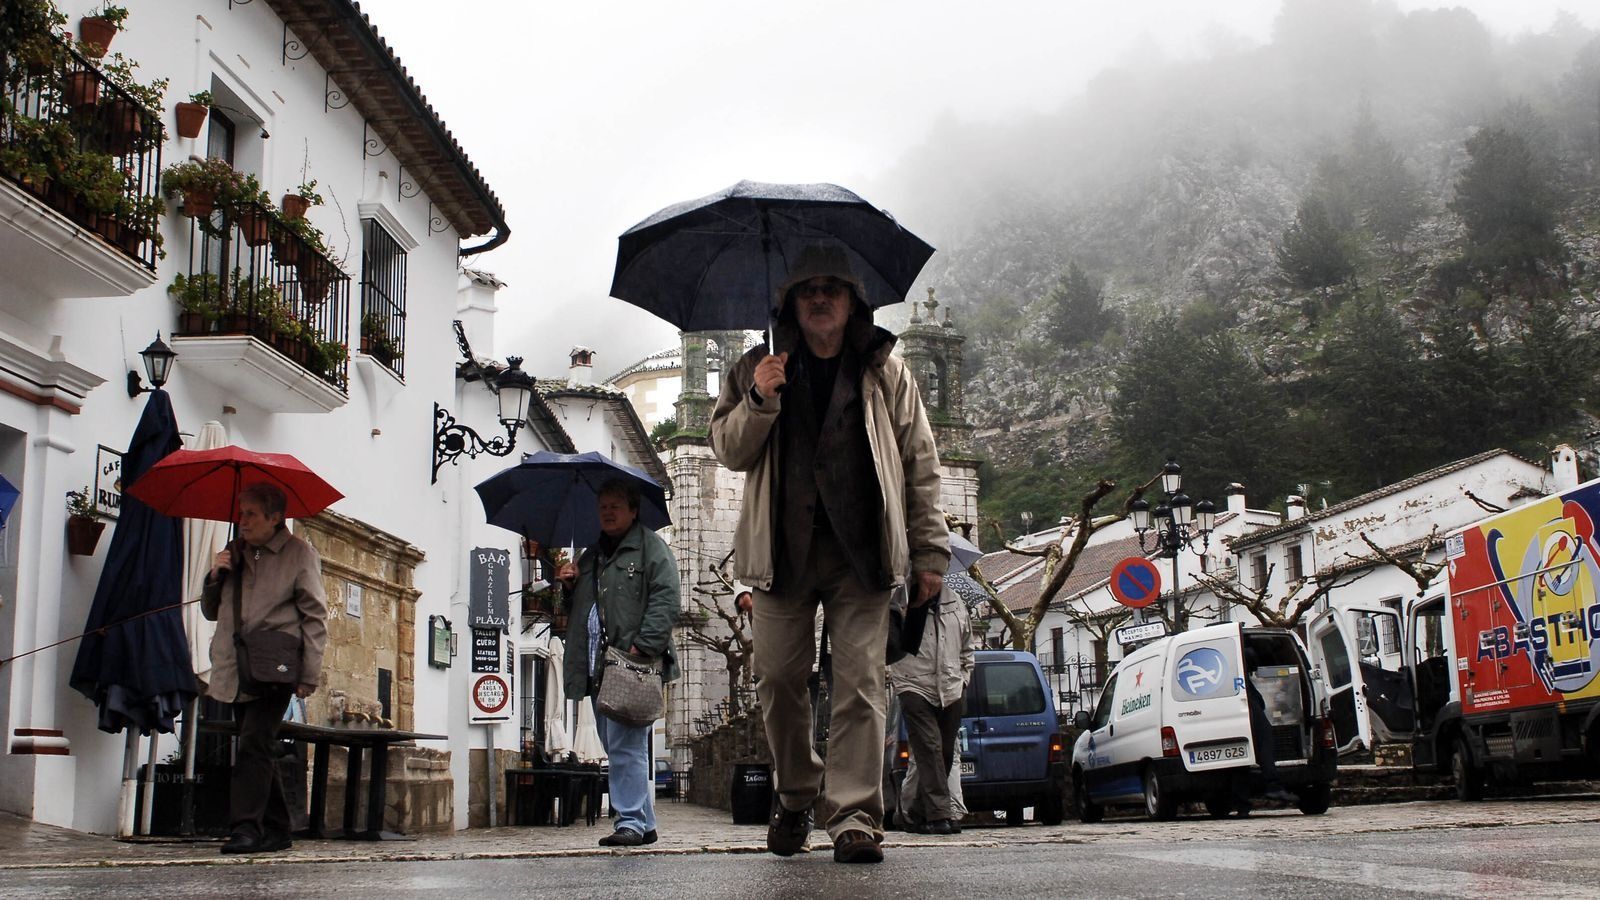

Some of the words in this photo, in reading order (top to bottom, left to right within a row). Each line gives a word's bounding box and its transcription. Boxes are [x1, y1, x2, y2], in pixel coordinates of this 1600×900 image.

[103, 460, 120, 476] CAF
[478, 552, 506, 566] BAR
[475, 614, 506, 625] PLAZA
[476, 638, 497, 646] CUERO
[1121, 693, 1151, 716] Heineken
[1197, 750, 1222, 761] 4897
[1224, 746, 1245, 758] GZS
